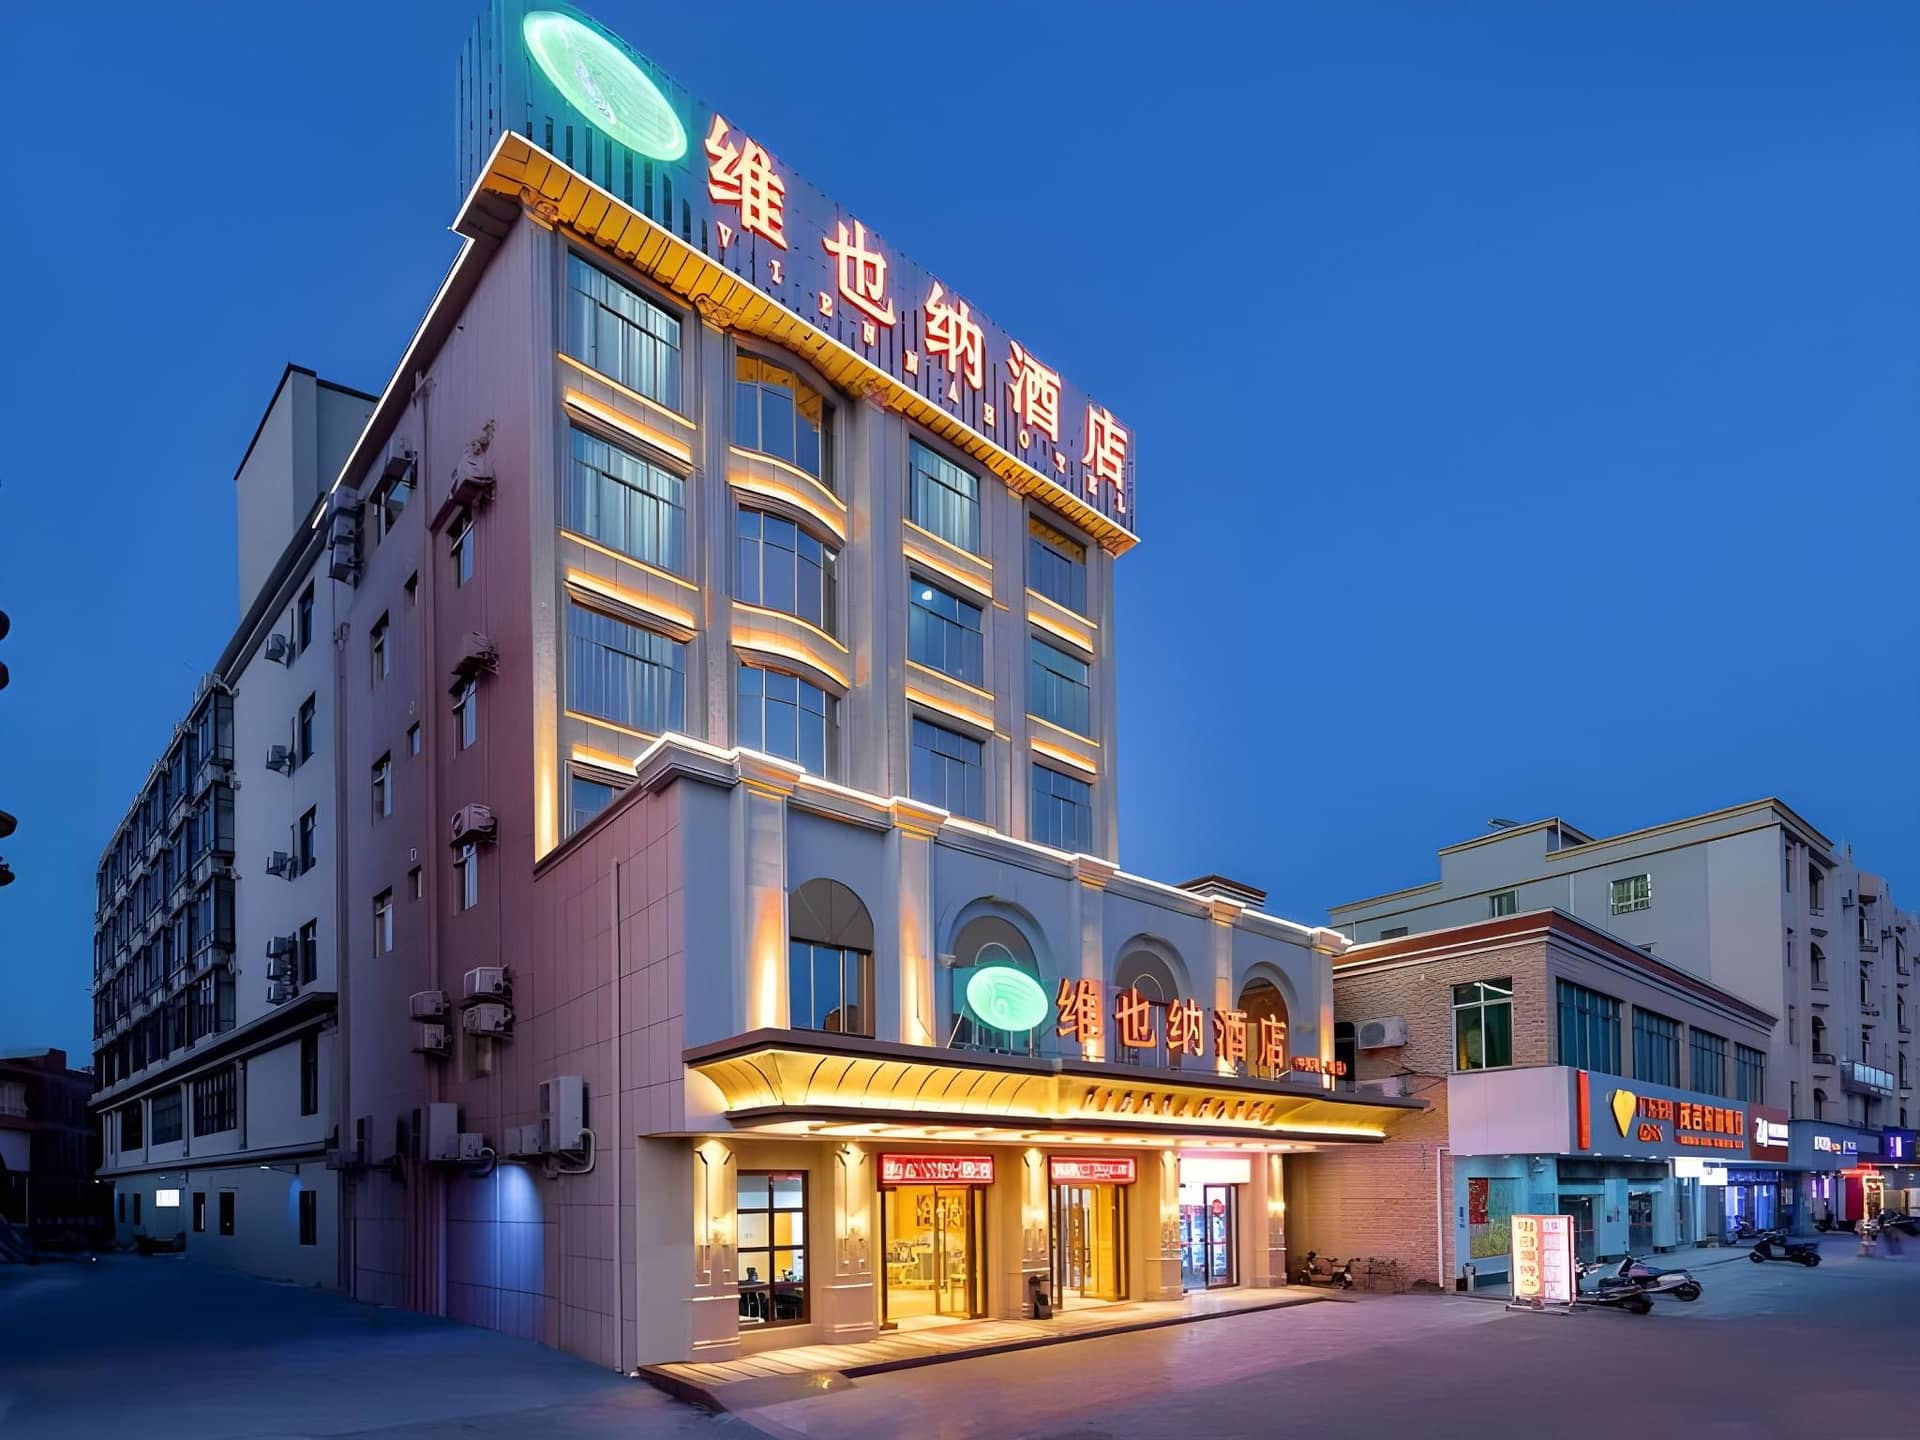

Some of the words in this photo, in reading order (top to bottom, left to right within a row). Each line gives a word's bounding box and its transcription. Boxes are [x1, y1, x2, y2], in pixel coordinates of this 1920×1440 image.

[703, 112, 1129, 494] 维也纳酒店
[1056, 977, 1288, 1070] 维也纳酒店
